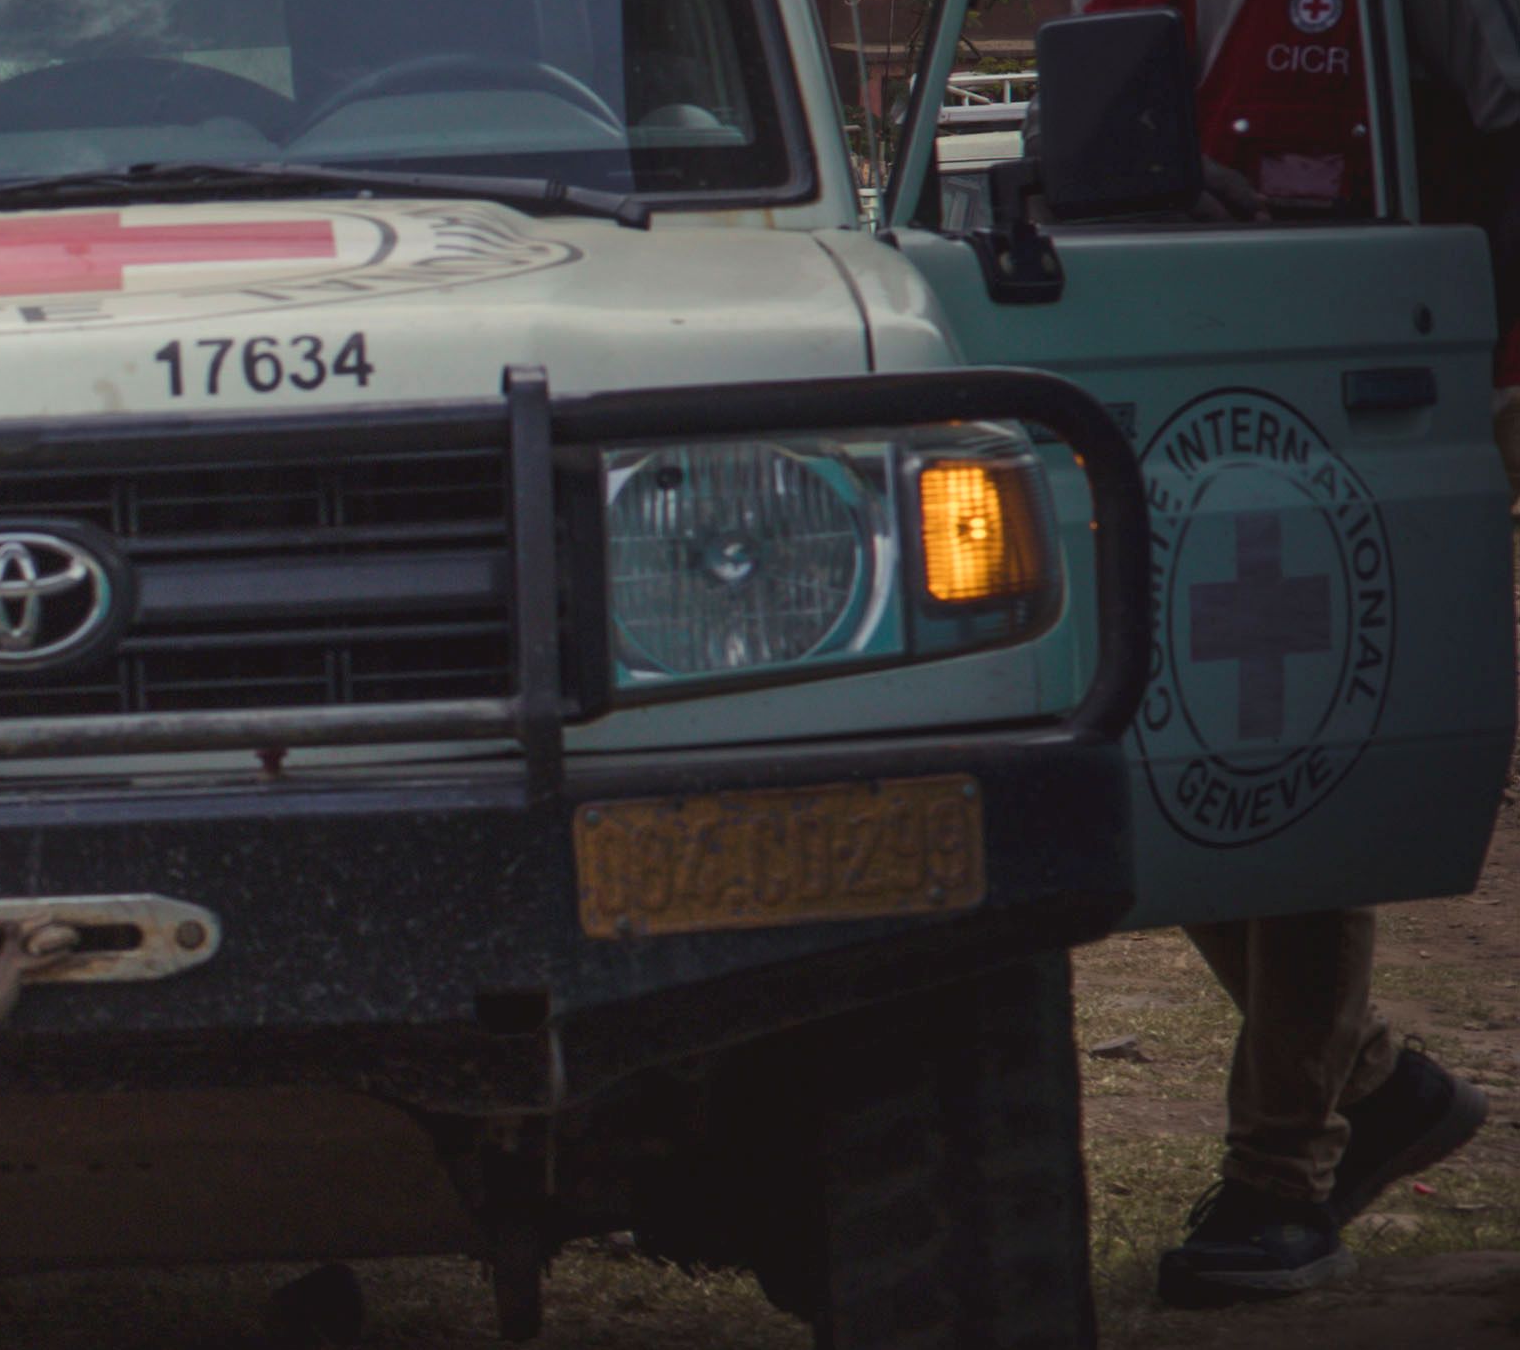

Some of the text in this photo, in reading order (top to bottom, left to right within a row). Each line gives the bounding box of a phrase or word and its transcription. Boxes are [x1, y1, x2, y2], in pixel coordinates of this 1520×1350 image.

[1266, 43, 1350, 74] CICR
[154, 330, 376, 398] 17634
[1164, 406, 1387, 705] INTERNATIONAL
[1175, 744, 1334, 832] GENEVE
